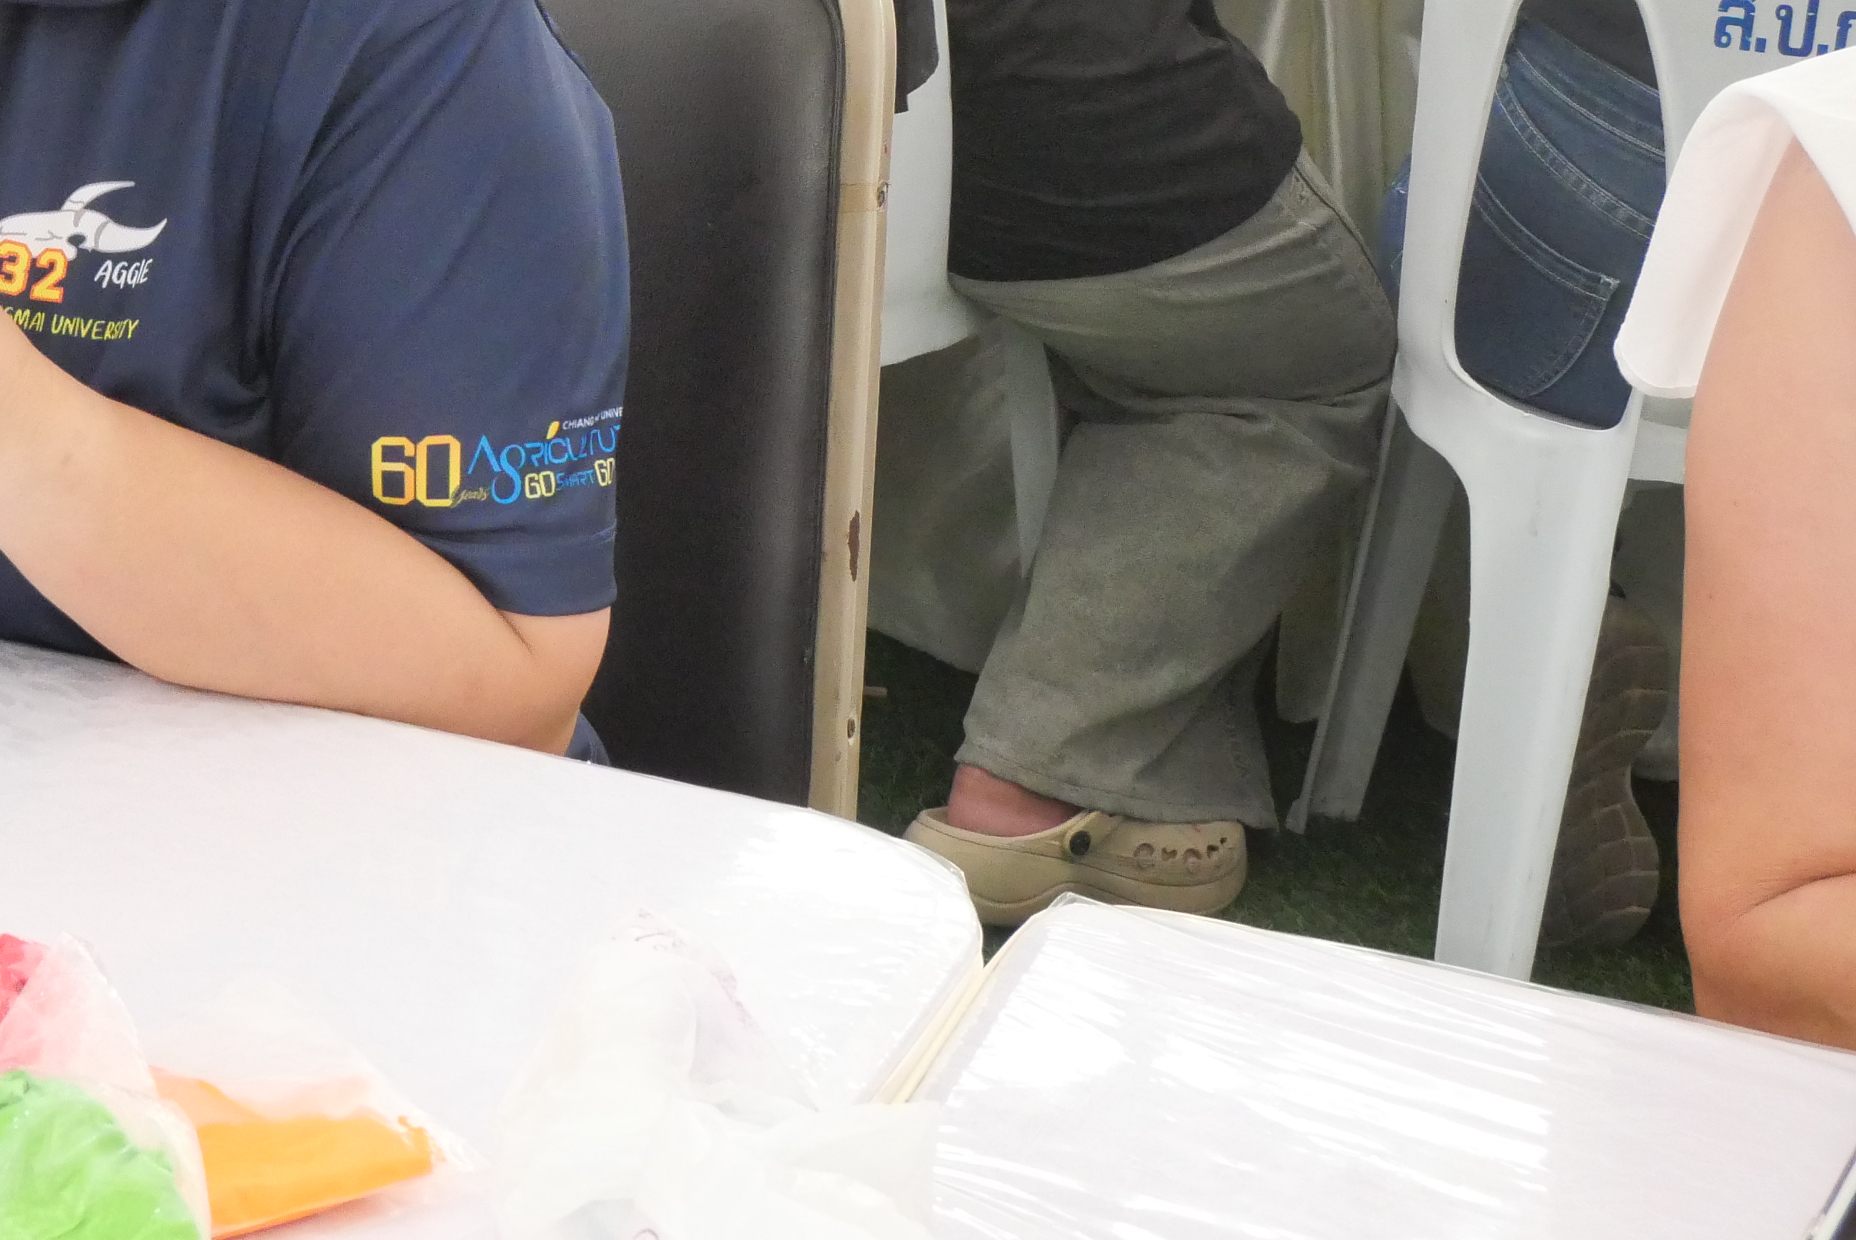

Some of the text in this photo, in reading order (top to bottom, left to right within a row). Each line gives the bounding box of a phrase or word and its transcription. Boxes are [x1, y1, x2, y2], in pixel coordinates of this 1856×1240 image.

[94, 258, 154, 289] AGGIE
[50, 313, 140, 340] UNIVERSITY
[371, 434, 462, 508] 60
